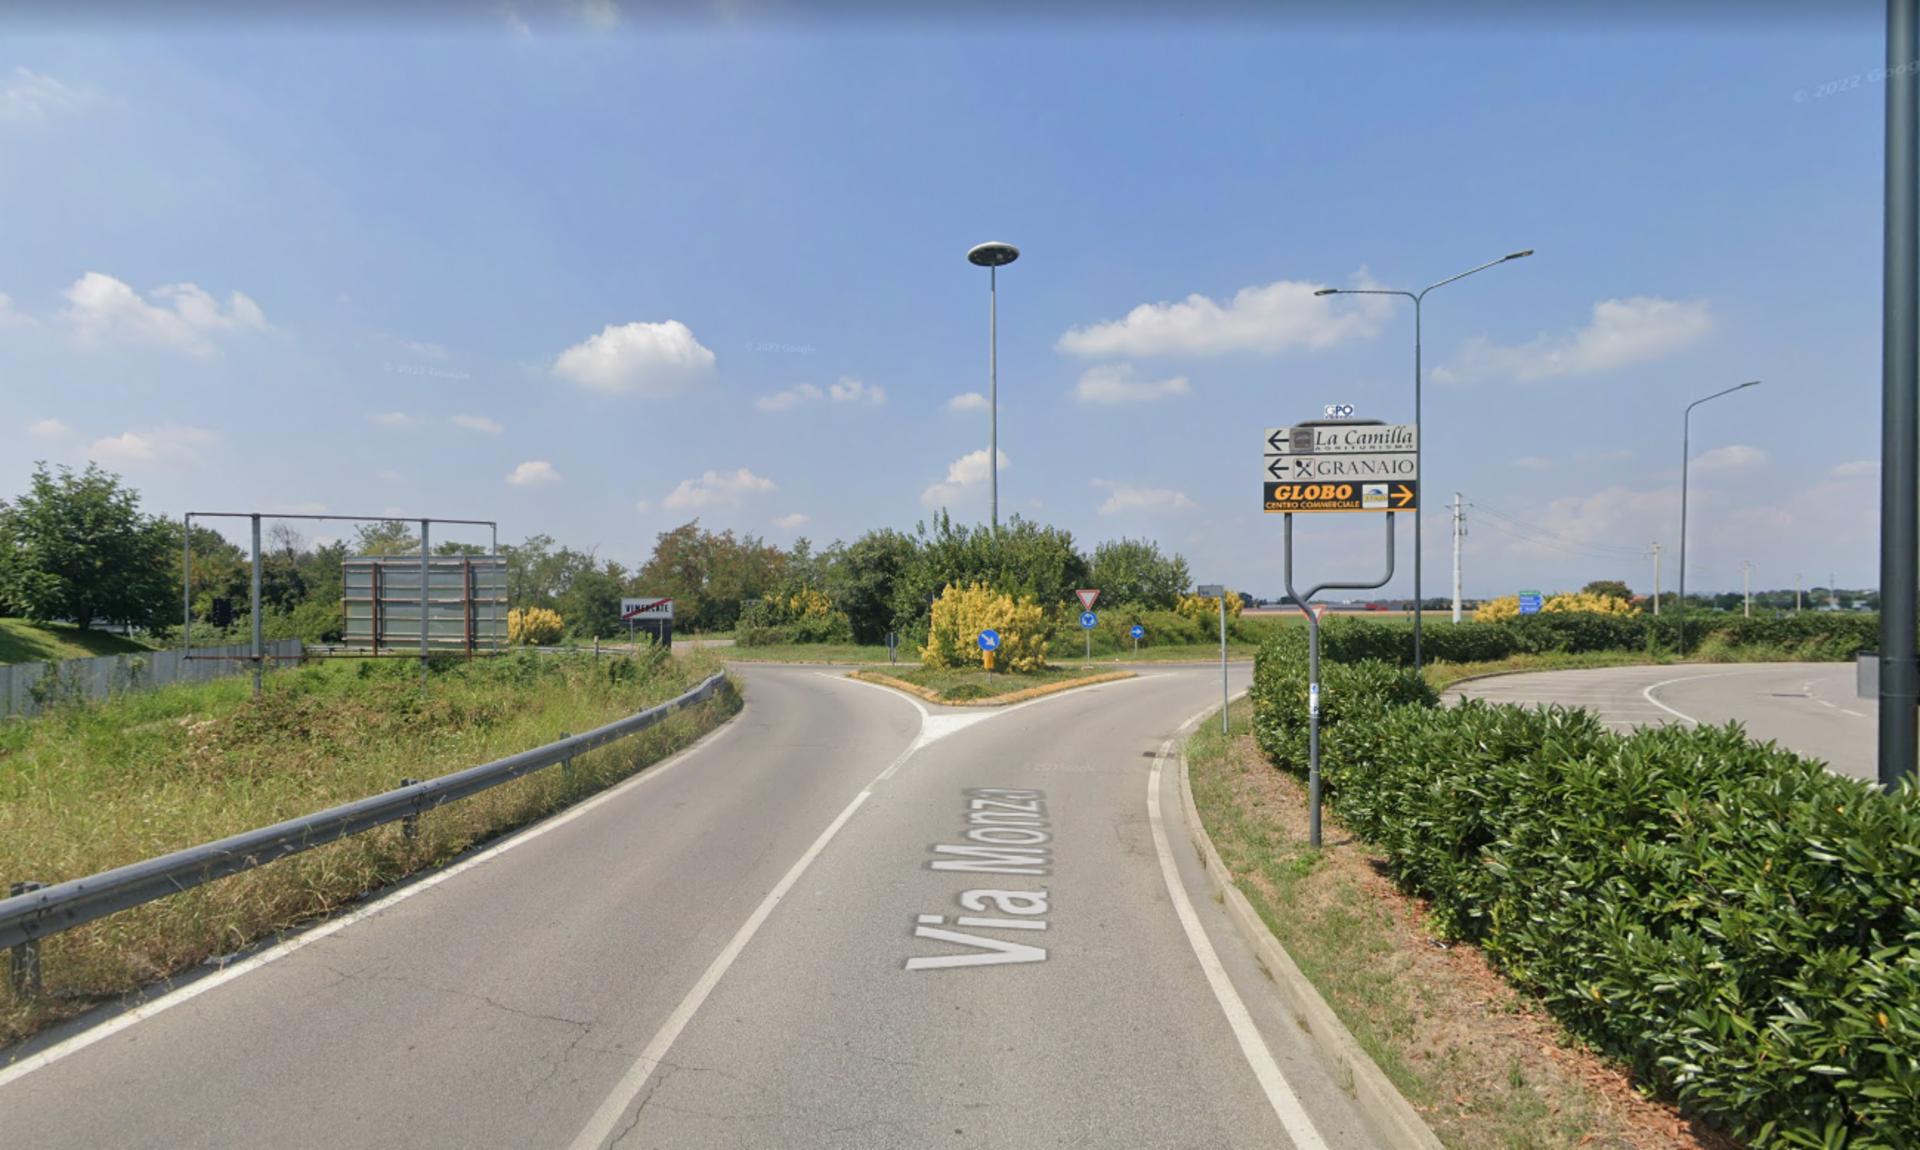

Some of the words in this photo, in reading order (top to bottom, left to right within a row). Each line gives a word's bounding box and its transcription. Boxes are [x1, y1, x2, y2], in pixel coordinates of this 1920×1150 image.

[1315, 431, 1337, 446] La
[1344, 425, 1413, 446] Camilla
[1317, 459, 1415, 475] GRANAIO
[1274, 484, 1353, 500] GLOBO
[1265, 501, 1299, 509] CENTRO
[1300, 500, 1360, 508] COMMERCIALE
